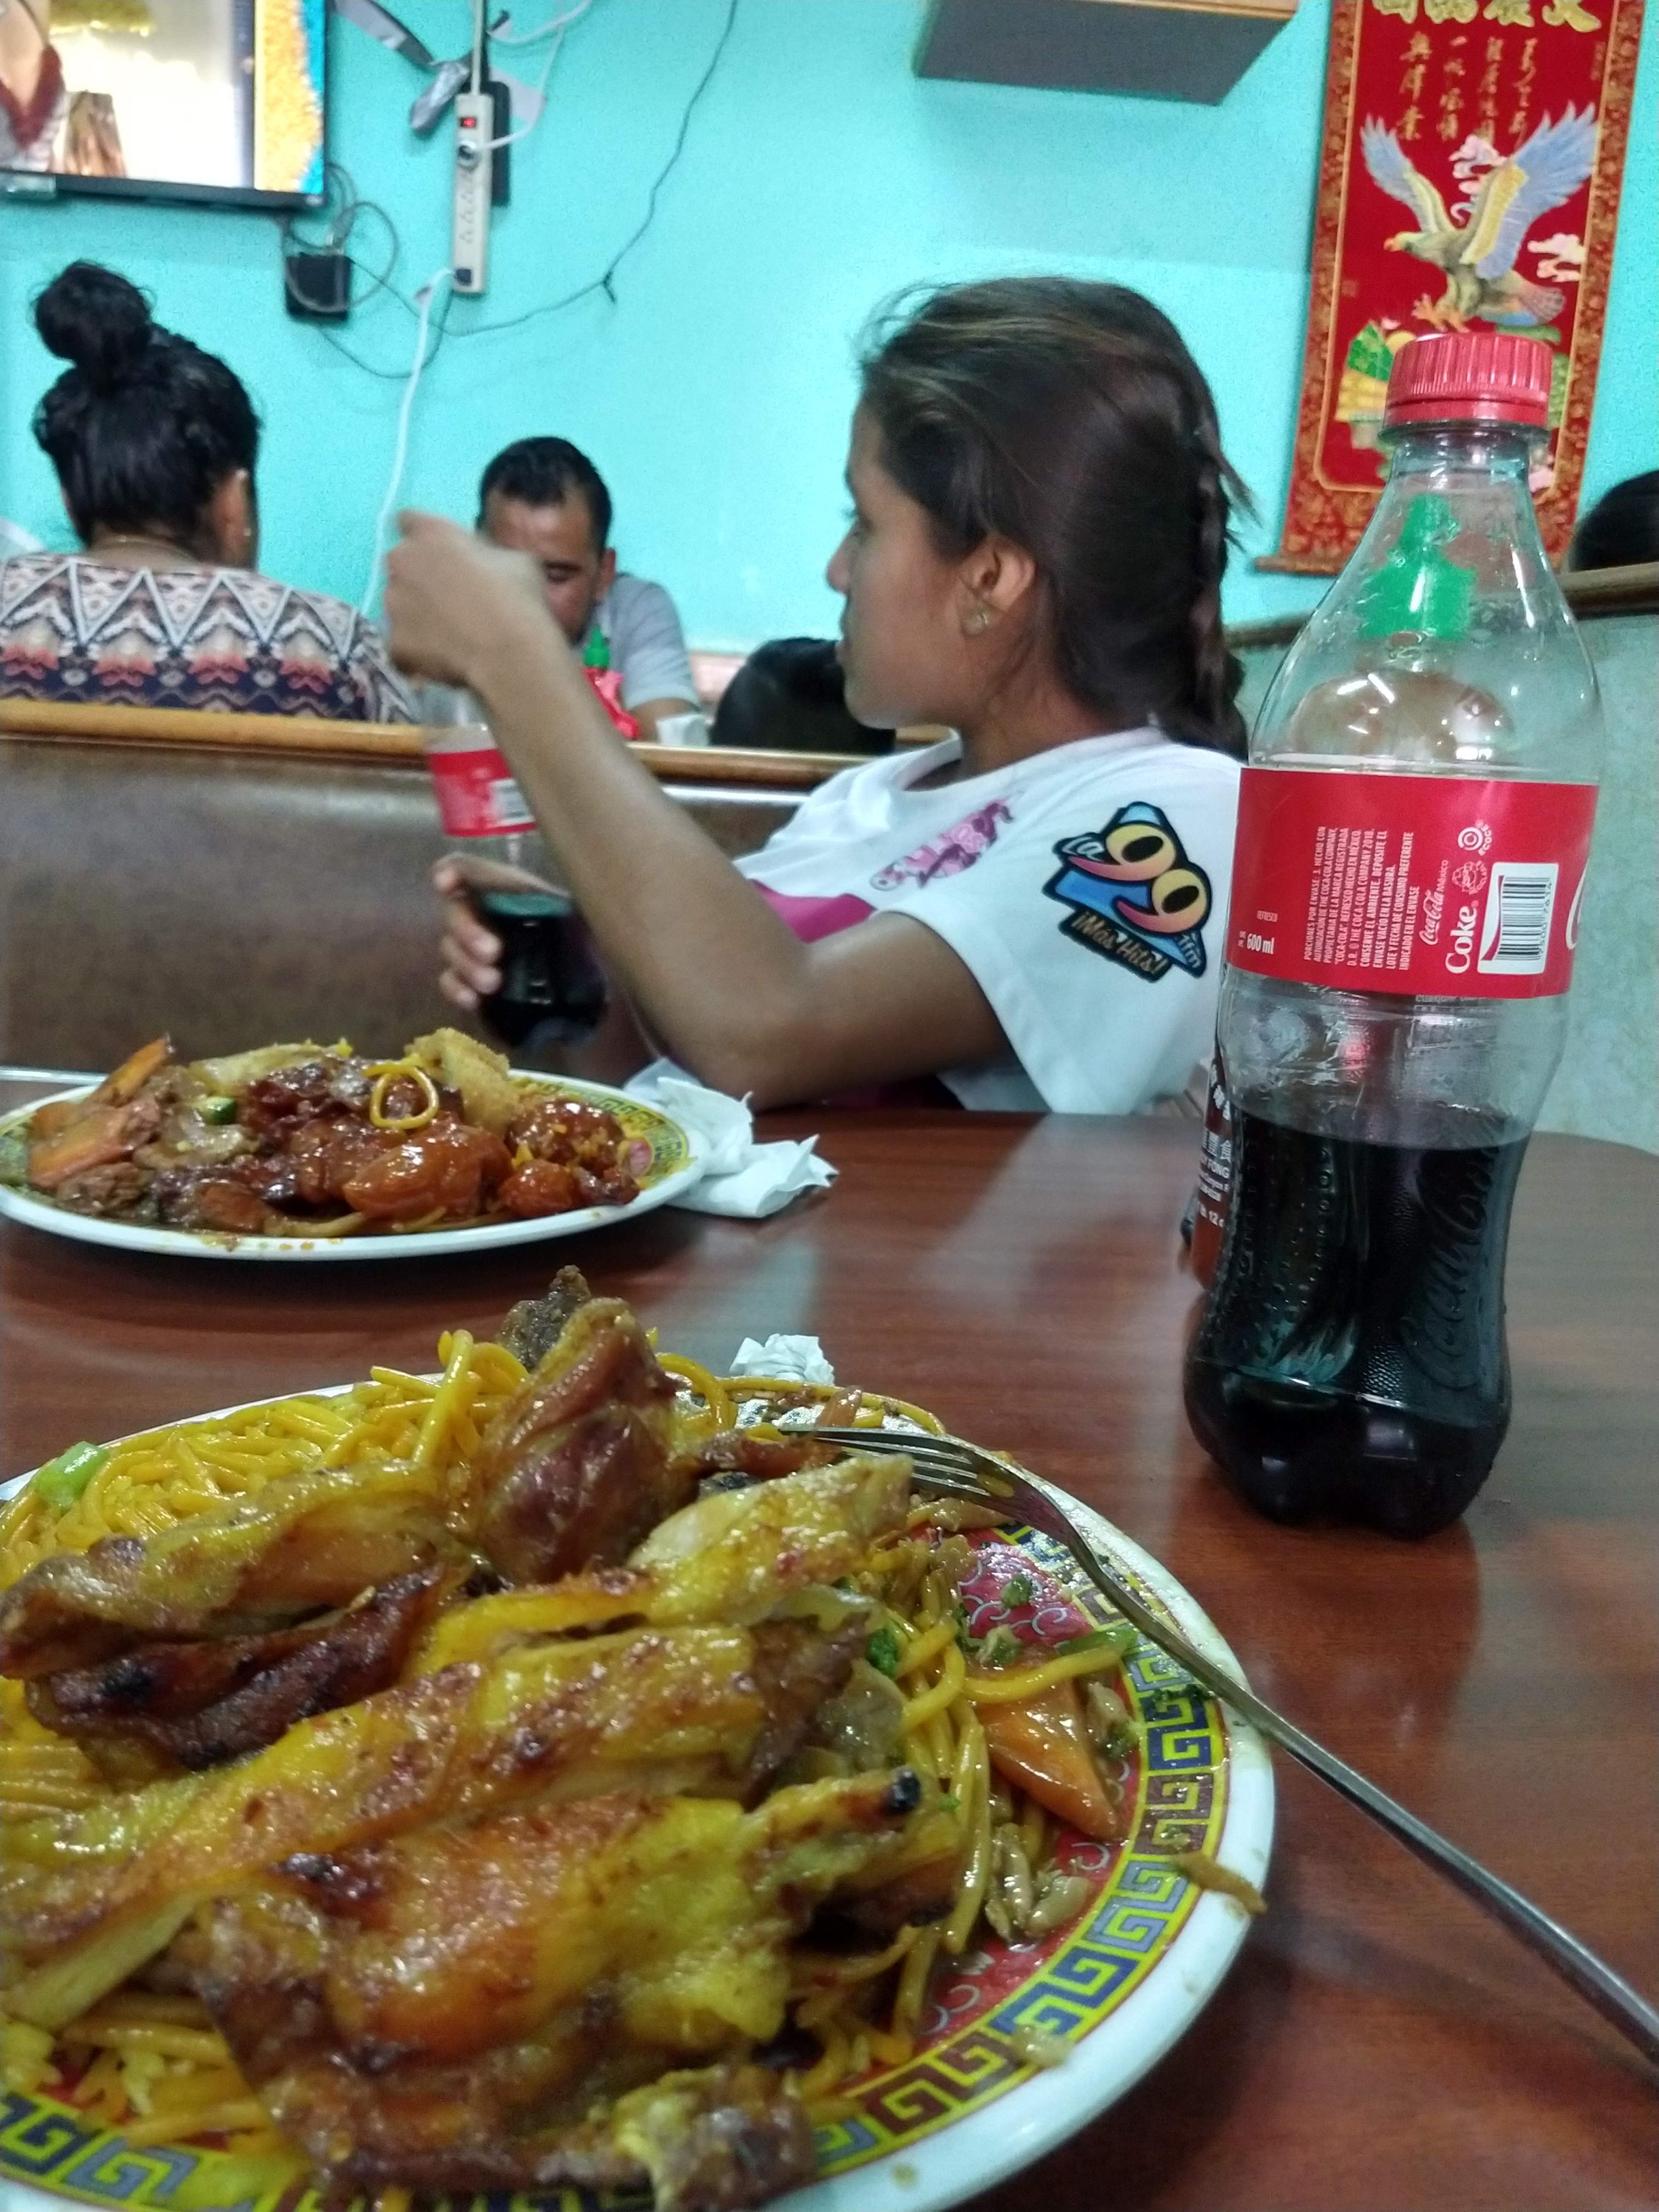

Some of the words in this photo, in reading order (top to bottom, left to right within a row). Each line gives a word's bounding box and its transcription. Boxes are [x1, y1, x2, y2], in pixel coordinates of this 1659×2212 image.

[1316, 826, 1326, 841] CON
[1376, 830, 1387, 839] EL
[1313, 842, 1324, 866] HECHO
[1334, 827, 1349, 872] REGISTRADA
[1347, 856, 1358, 866] EN
[1371, 839, 1386, 877] DEPOSITE
[1397, 831, 1413, 876] PREFERENTE
[1330, 872, 1343, 898] MARCA
[1344, 866, 1357, 889] HECHO
[1319, 895, 1328, 907] THE
[1329, 897, 1339, 907] LA
[1340, 889, 1353, 922] REFRESCO
[1350, 927, 1362, 942] THE
[1357, 849, 1372, 885] COMPANY
[1380, 896, 1391, 907] LA
[1393, 876, 1407, 912] CONSUMO
[1406, 885, 1420, 915] ENVASE
[1307, 906, 1317, 921] POR
[1318, 908, 1327, 917] DE
[1328, 907, 1338, 918] DE
[1379, 906, 1390, 917] EN
[1391, 912, 1403, 923] DE
[1404, 914, 1415, 924] EL
[1364, 919, 1375, 929] EL
[1389, 922, 1402, 946] FECHA
[1403, 923, 1414, 935] EN
[1246, 933, 1262, 952] 600
[1262, 937, 1275, 955] ml
[1303, 922, 1315, 960] PORCIONES
[1323, 917, 1337, 963] PROPIETARIA
[1359, 929, 1374, 967] CONSERVE
[1445, 906, 1477, 974] Coke
[1372, 940, 1386, 968] ENVASE
[1385, 951, 1398, 969] LOTE
[1398, 934, 1413, 970] INDICADO
